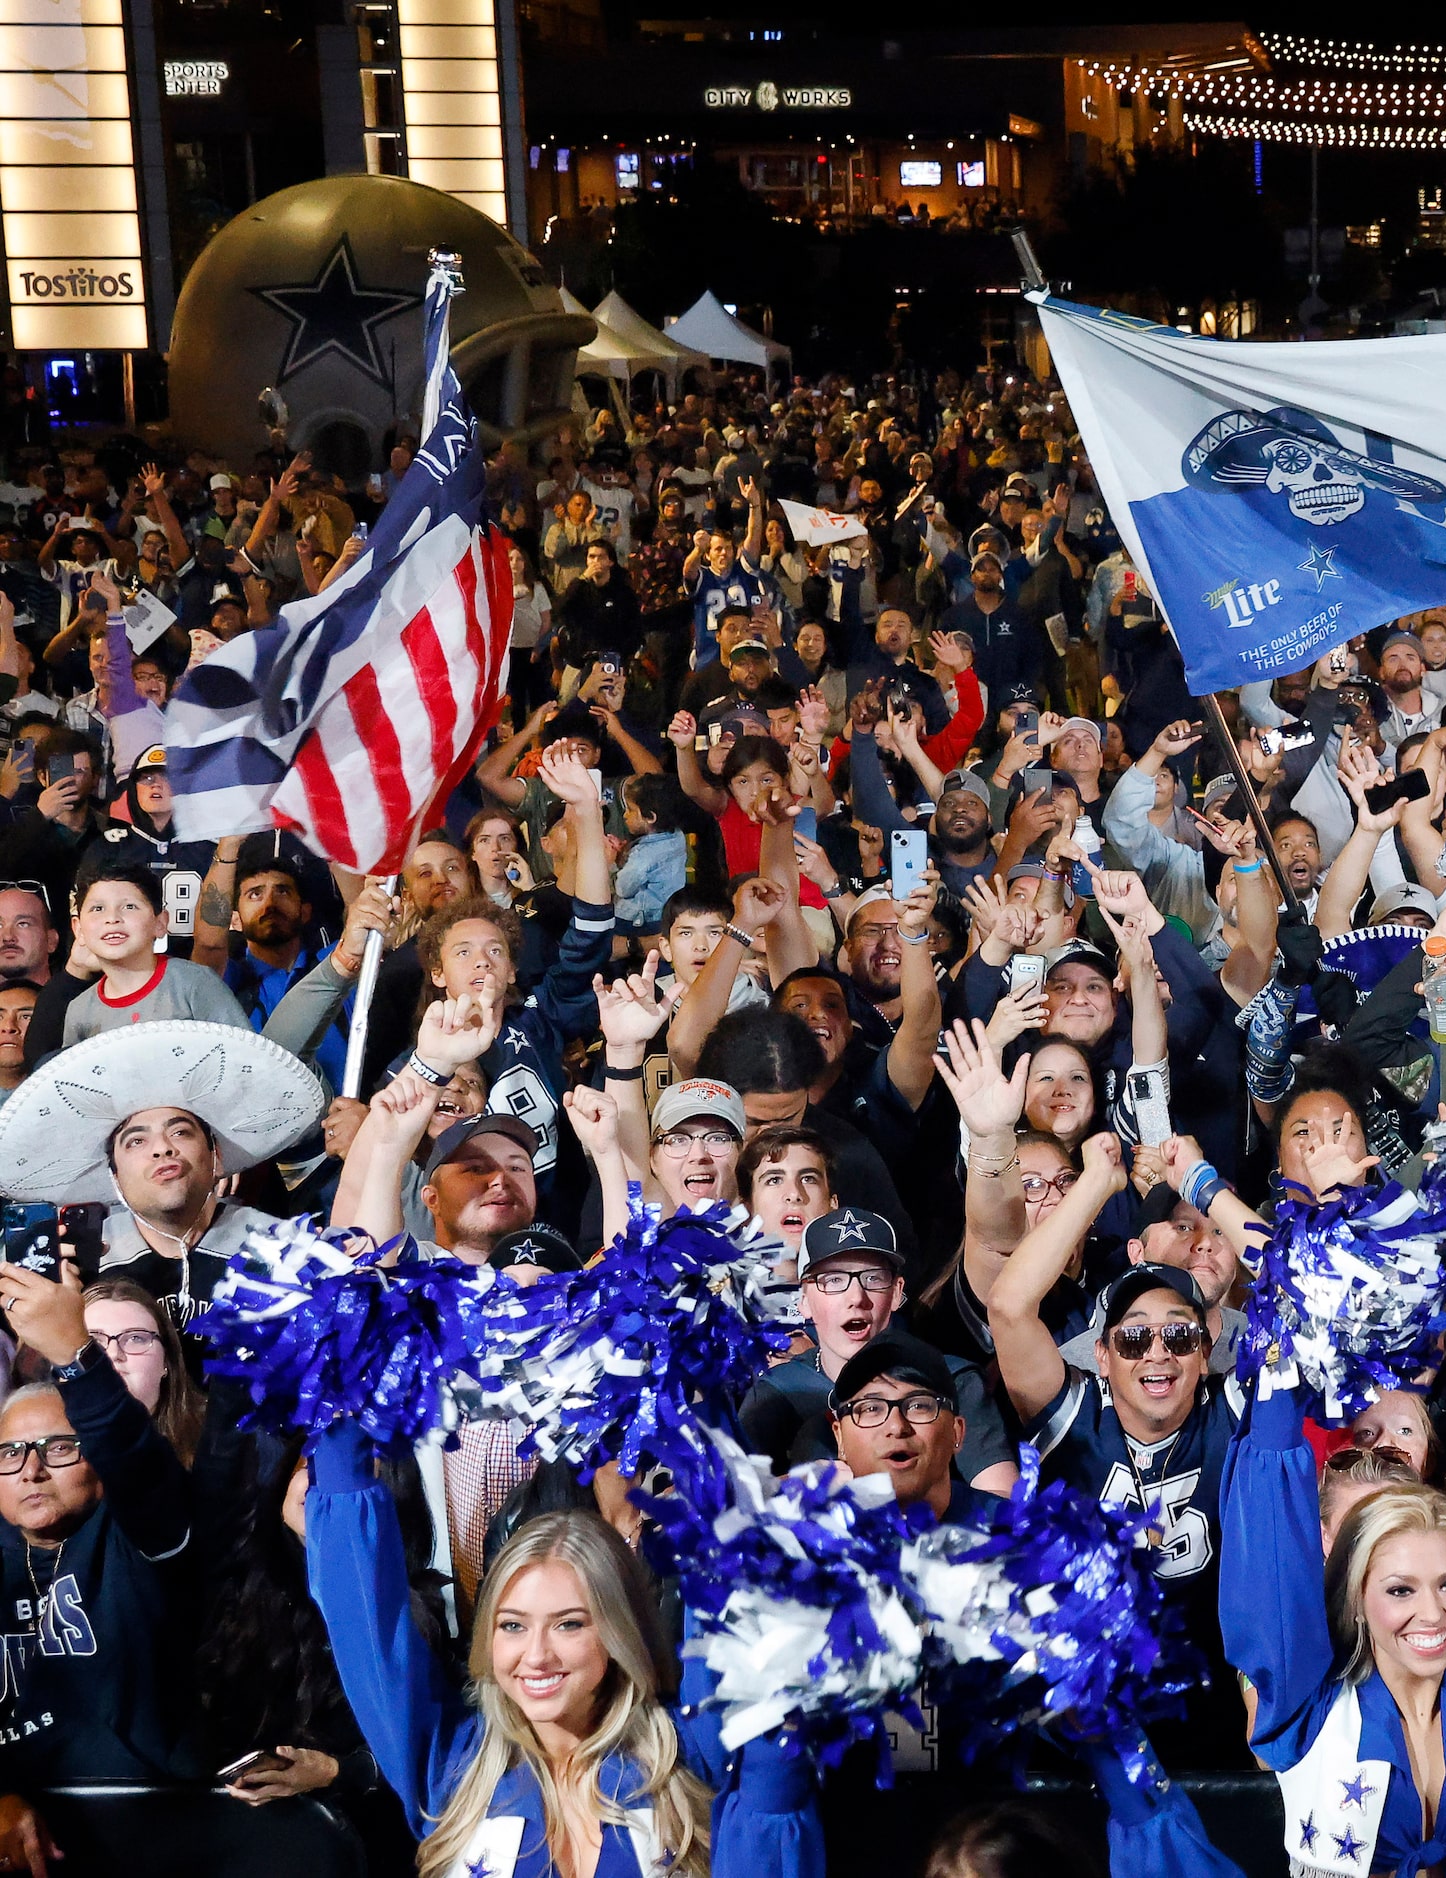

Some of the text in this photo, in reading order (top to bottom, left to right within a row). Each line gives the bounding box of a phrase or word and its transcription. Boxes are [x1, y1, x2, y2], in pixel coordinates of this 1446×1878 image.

[705, 89, 850, 106] CITY WORKS
[1220, 578, 1281, 629] Lite
[1238, 601, 1344, 663] THE ONLY BEER OF
[1253, 620, 1338, 671] THE COWBOYS
